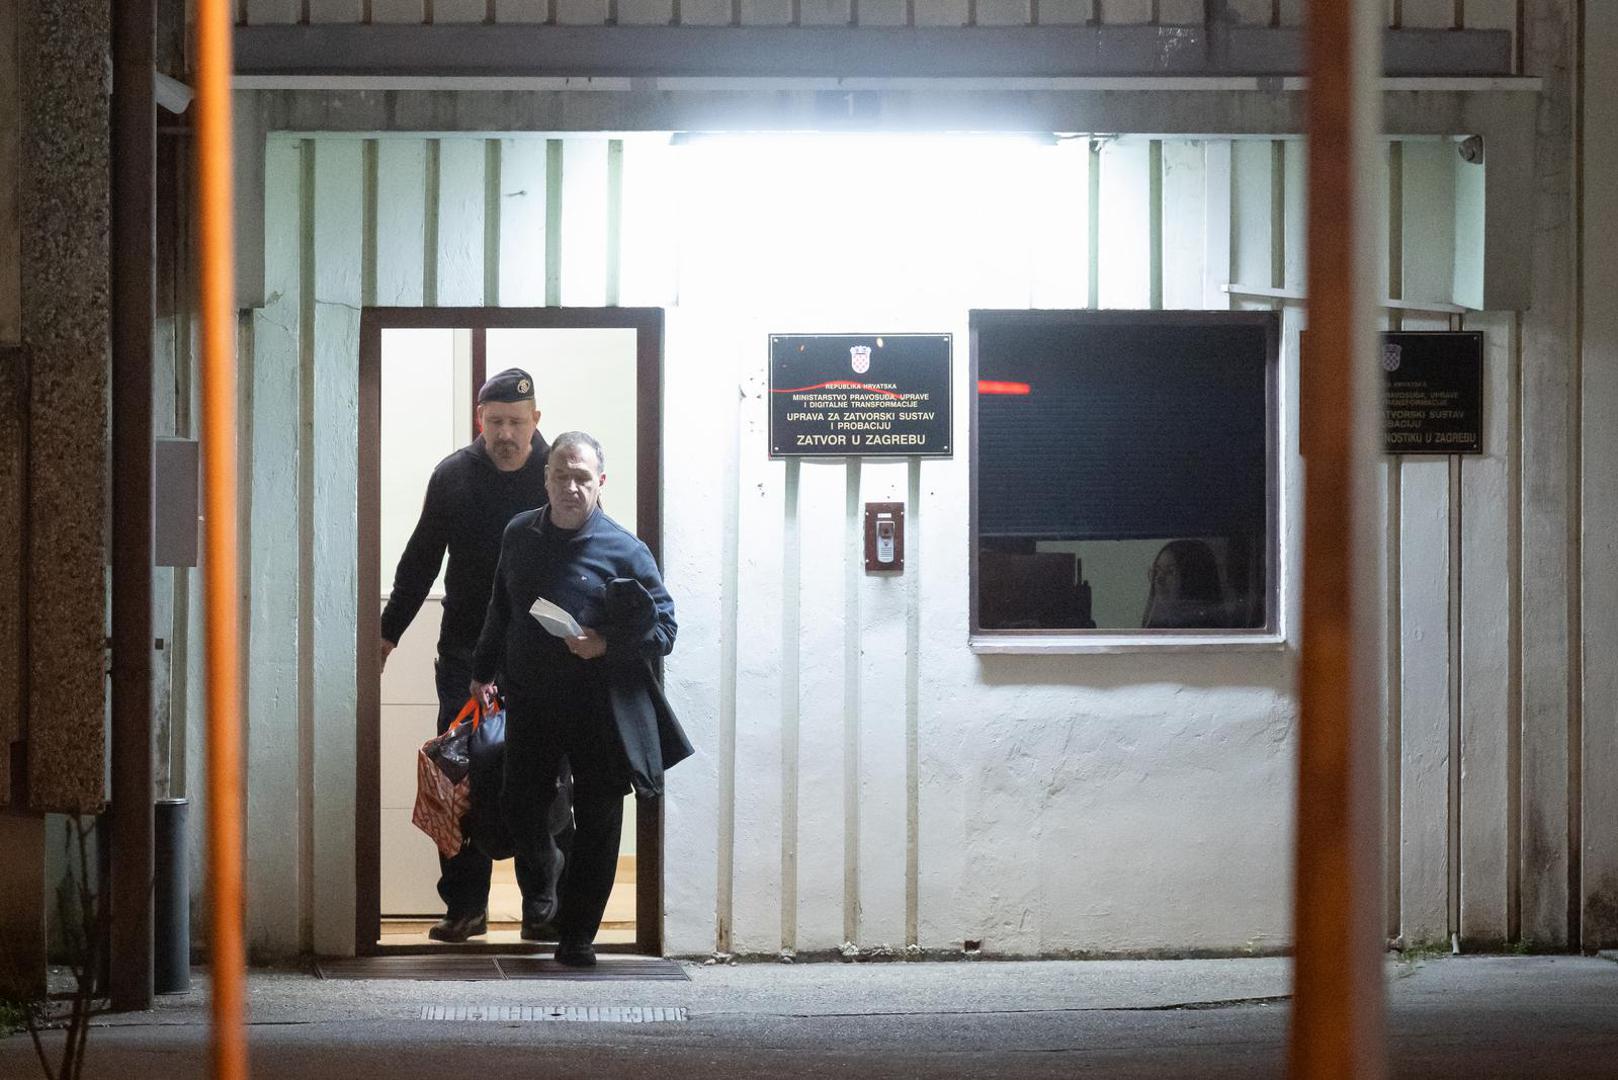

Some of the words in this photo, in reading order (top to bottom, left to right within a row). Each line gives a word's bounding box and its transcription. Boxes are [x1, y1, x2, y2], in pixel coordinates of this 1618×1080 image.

[786, 412, 825, 421] UPRAVA
[827, 412, 840, 421] ZA
[843, 412, 896, 421] ZATVORSKI
[898, 412, 935, 420] SUSTAV
[830, 422, 834, 430] I
[837, 422, 892, 430] PROBACIJU
[796, 434, 847, 446] ZATVOR
[851, 434, 861, 446] U
[865, 434, 926, 446] ZAGREBU
